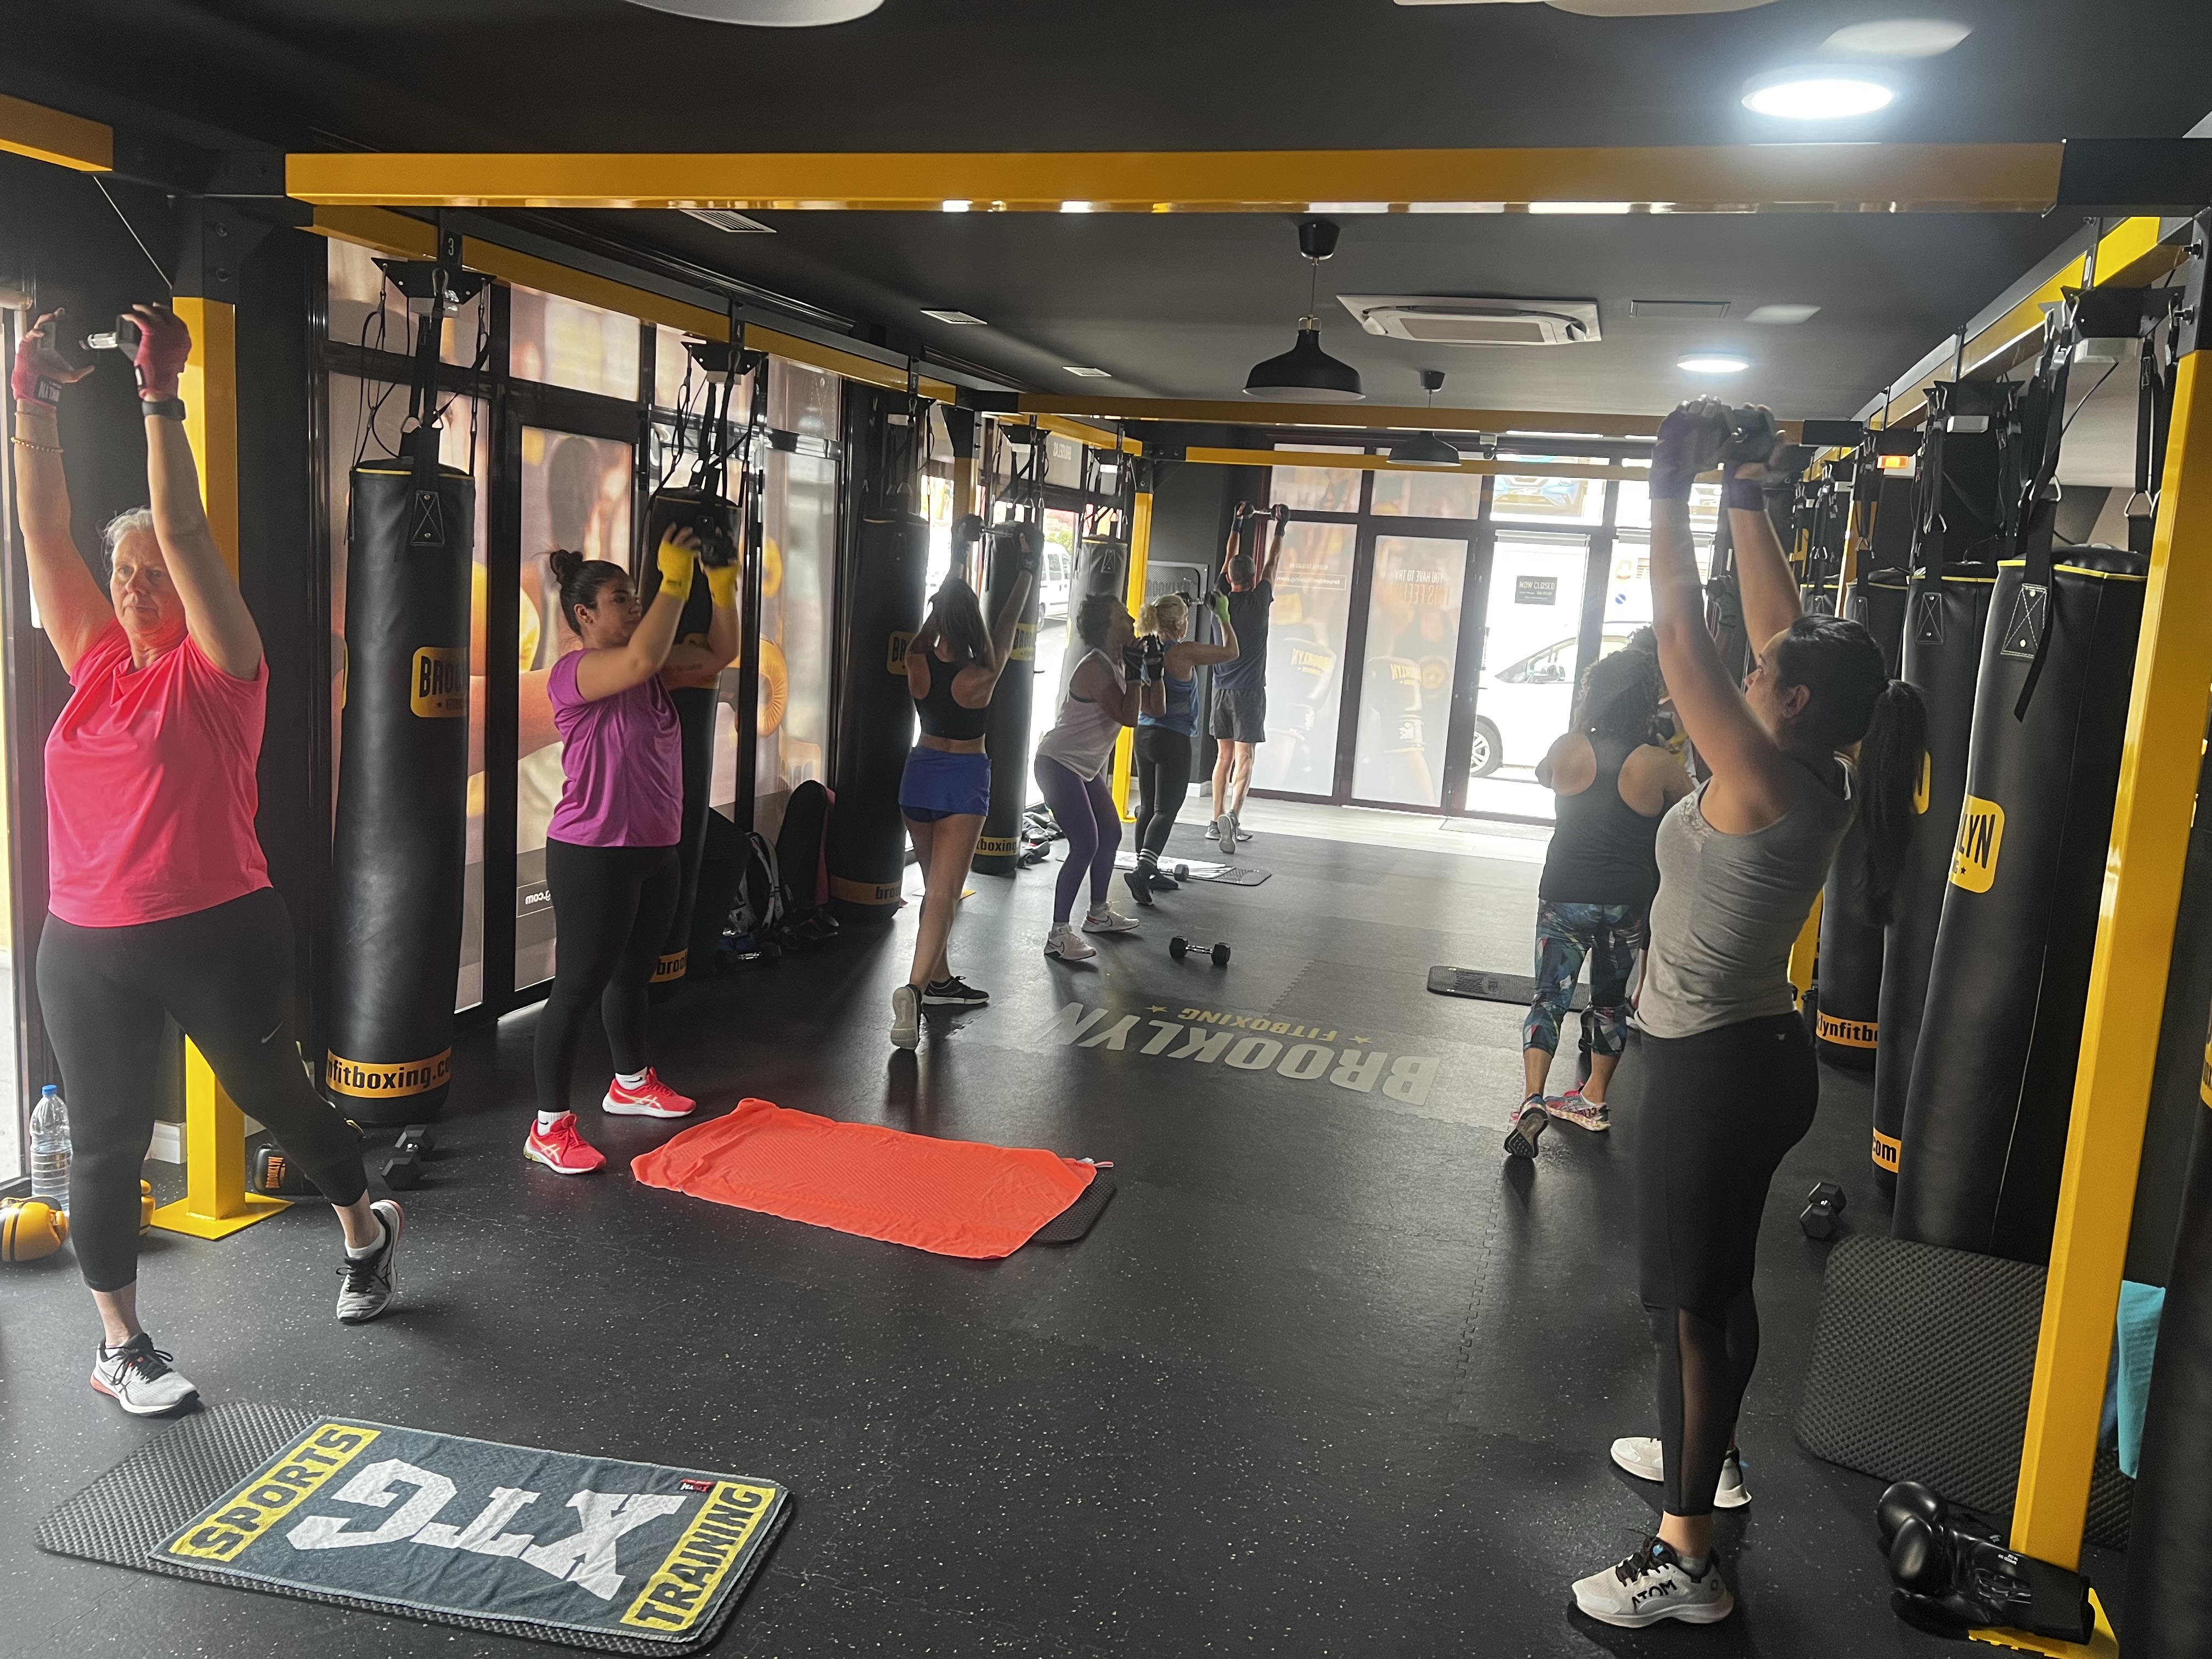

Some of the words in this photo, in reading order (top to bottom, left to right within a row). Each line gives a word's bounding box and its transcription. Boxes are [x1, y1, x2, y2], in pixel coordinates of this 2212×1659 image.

[448, 238, 454, 256] 3
[736, 324, 741, 338] 4
[1533, 582, 1555, 590] CLOSED
[1177, 1007, 1338, 1042] FITBOXING
[1029, 1002, 1441, 1105] BROOKLYN
[187, 1428, 362, 1556] SPORTS
[632, 1487, 764, 1626] TRAINING
